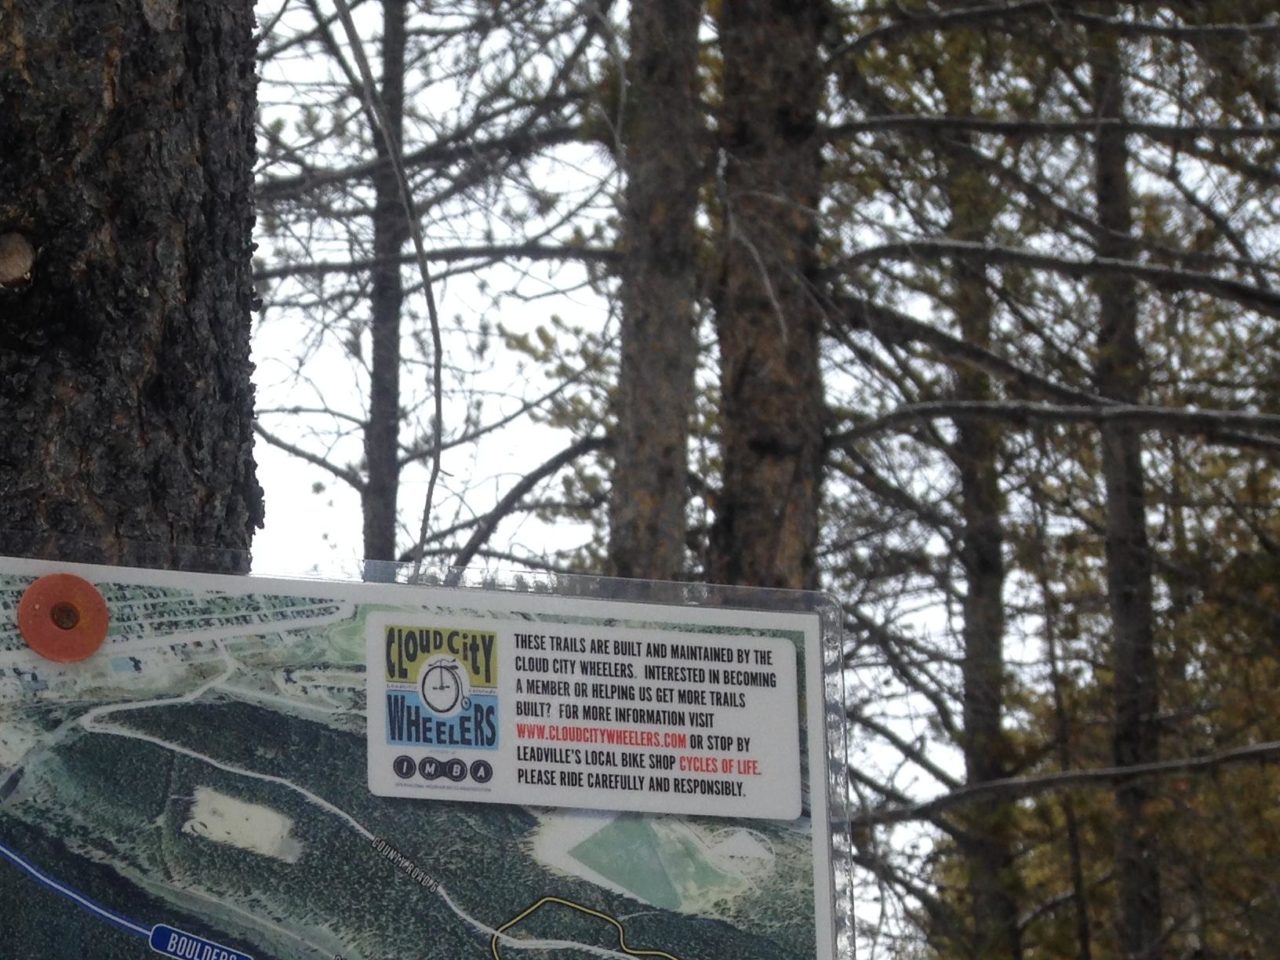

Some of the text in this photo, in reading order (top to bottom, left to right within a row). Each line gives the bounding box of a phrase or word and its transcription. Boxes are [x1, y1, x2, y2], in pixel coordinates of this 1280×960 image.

[514, 633, 773, 666] THESE TRAILS ARE BUILT AND MAINTAINED BY THE
[515, 656, 777, 688] CLOUD CITY WHEELERS. INTERESTED IN BECOMING
[516, 678, 746, 708] A MEMBER OR HELPING US GET MORE TRAILS
[516, 701, 714, 728] BUILT? FOR MORE INFORMATION VISIT
[516, 723, 750, 752] WWW.CLOUDCITYWHEELERS.COM OR STOP BY
[517, 745, 762, 776] LEADVILLE'S LOCAL BIKE SHOP CYCLES OF LIFE.
[517, 768, 746, 797] PLEASE RIDE CAREFULLY AND RESPONSIBLY.
